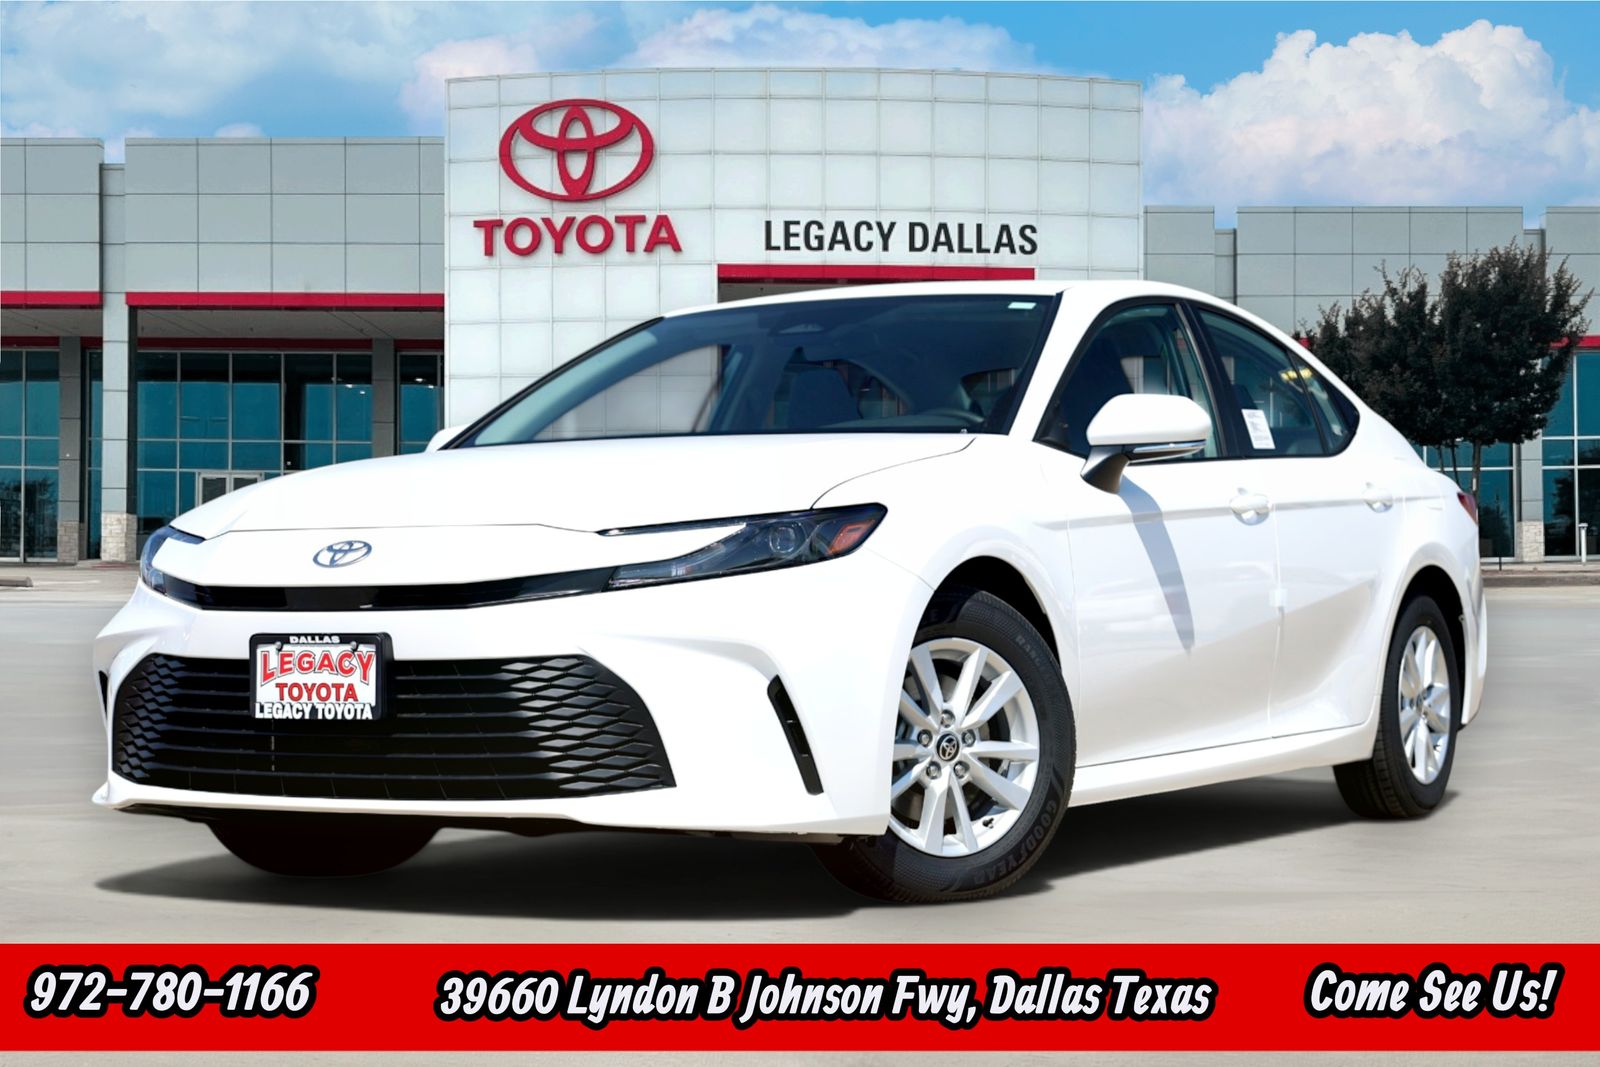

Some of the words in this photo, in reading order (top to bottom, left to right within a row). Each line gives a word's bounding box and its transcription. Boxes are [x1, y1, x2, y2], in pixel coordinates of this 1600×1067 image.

[473, 214, 682, 257] TOYOTA
[764, 219, 897, 253] LEGACY
[907, 220, 1039, 255] DALLAS
[289, 636, 340, 644] DALLAS
[262, 651, 375, 686] LEGACY
[276, 683, 358, 702] TOYOTA
[255, 703, 312, 719] LEGACY
[316, 703, 373, 720] TOYOTA
[974, 799, 1057, 884] GOODYEAR
